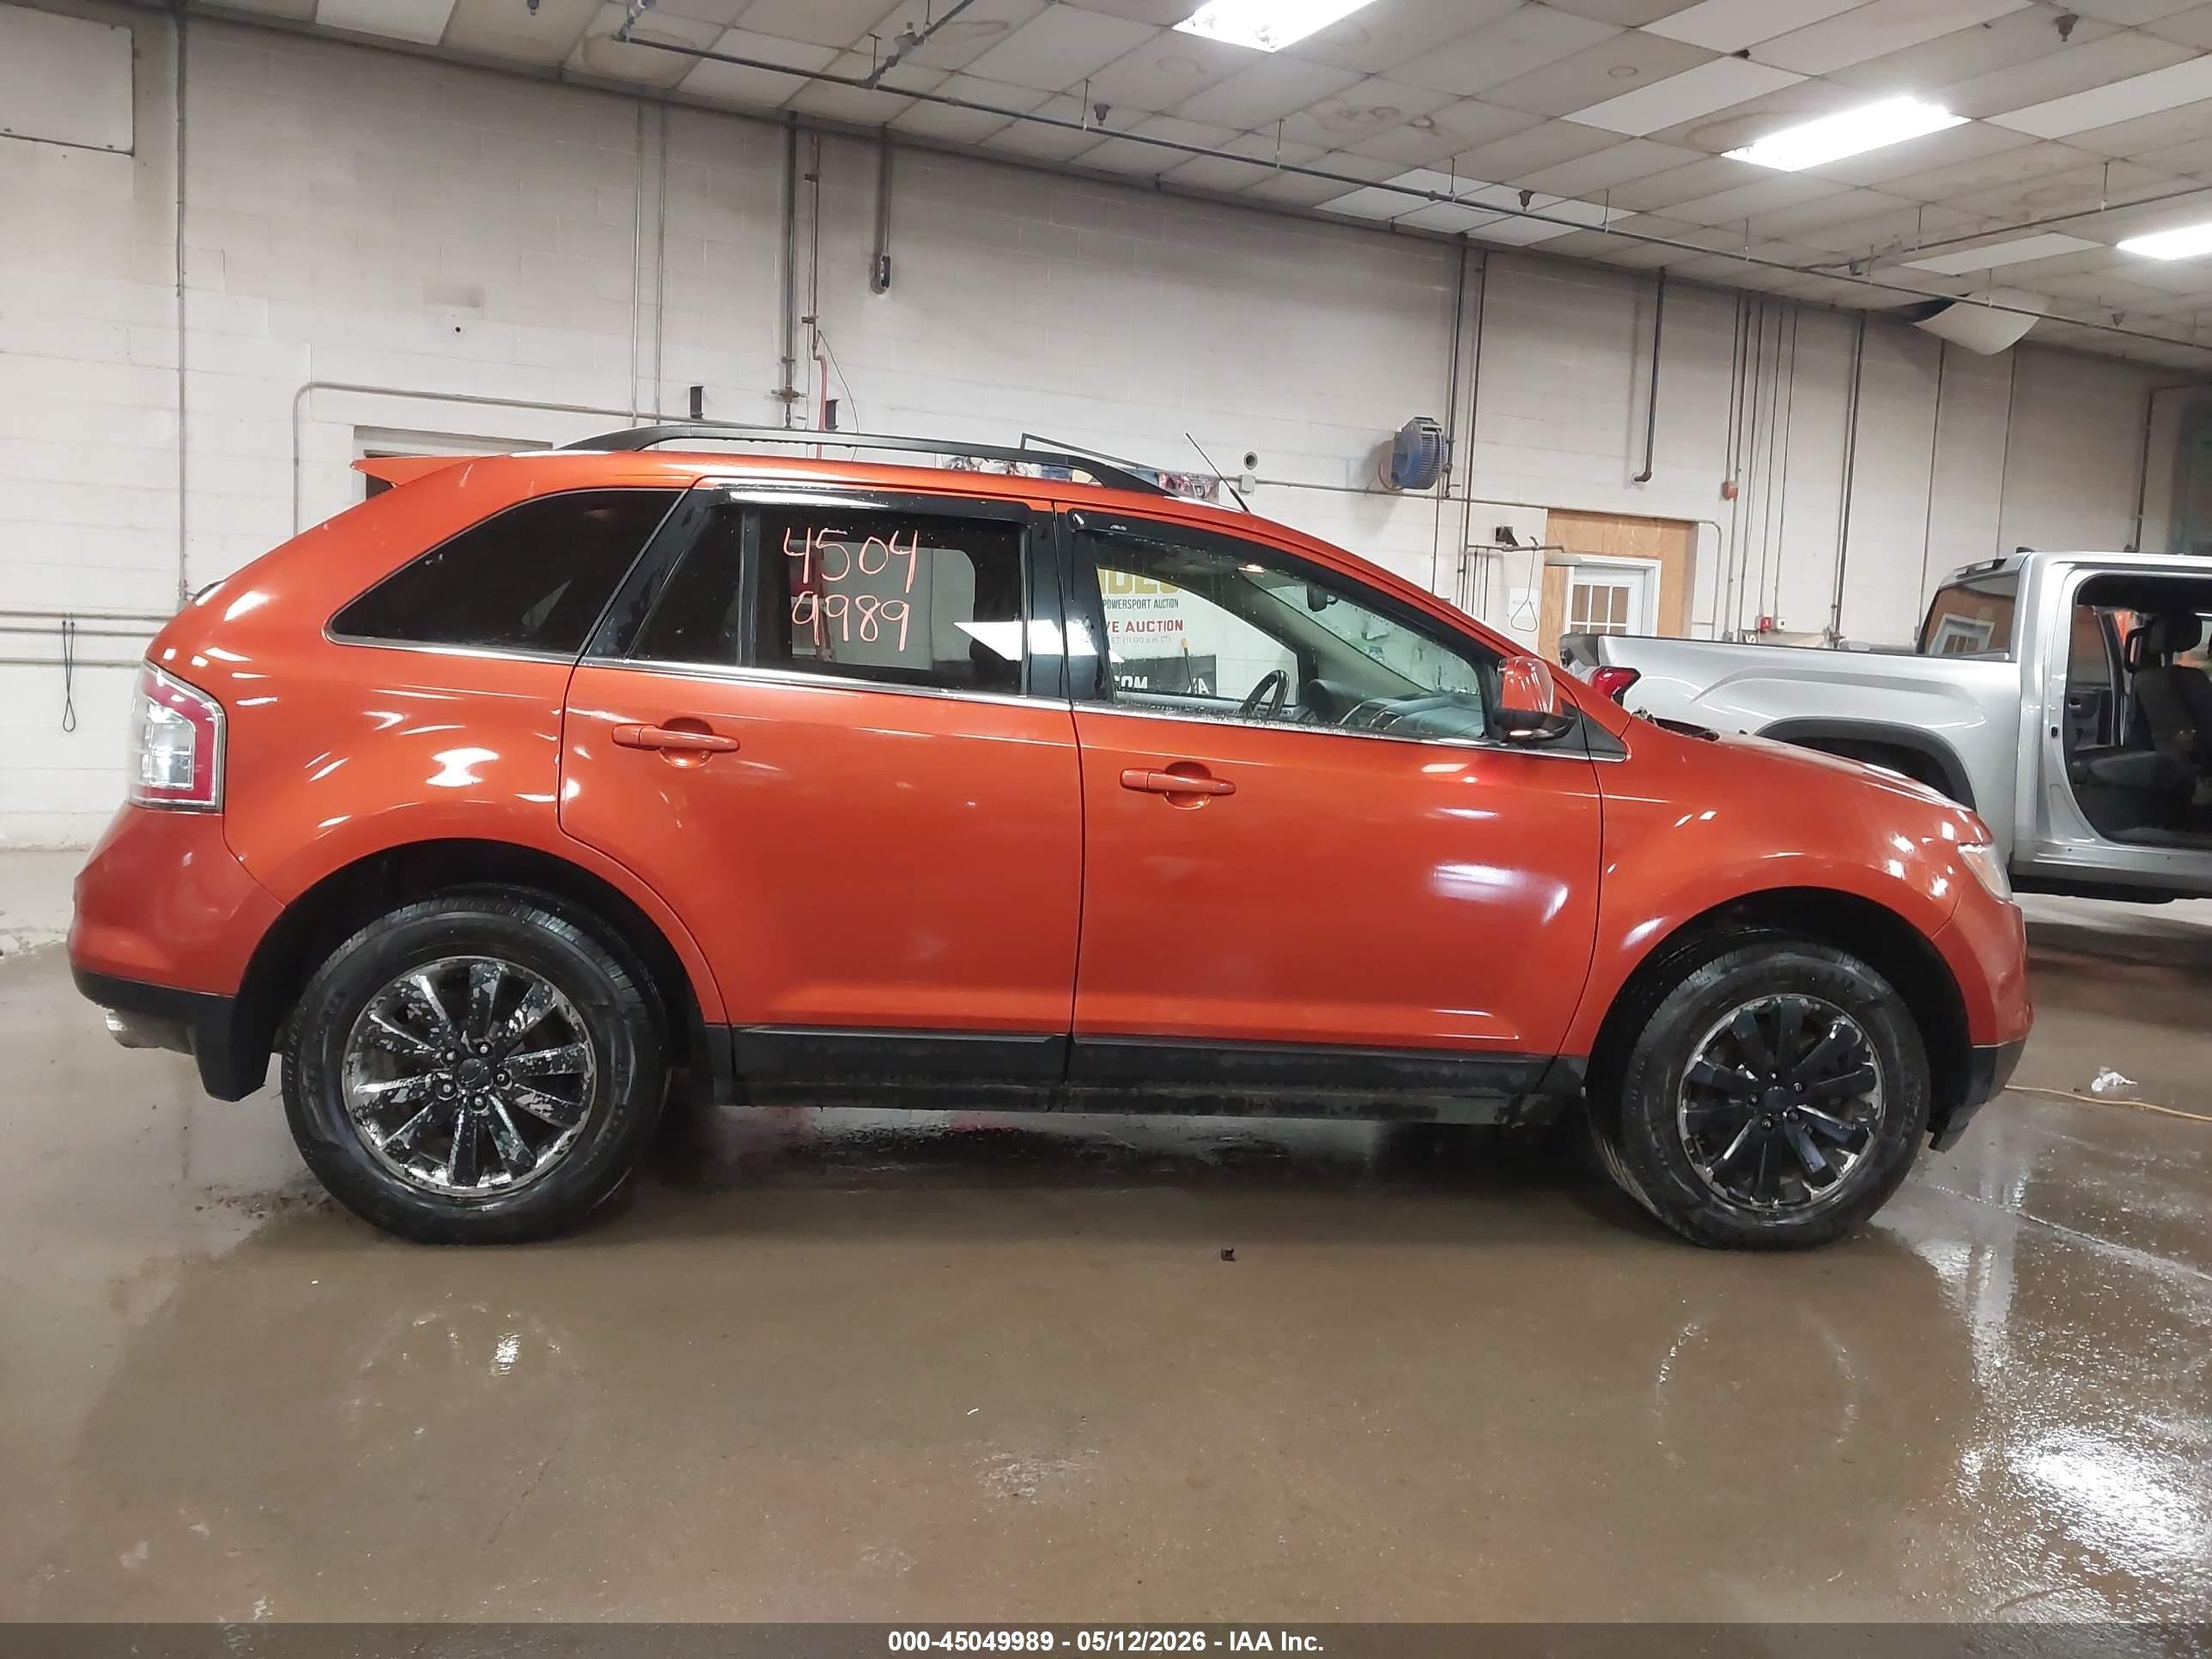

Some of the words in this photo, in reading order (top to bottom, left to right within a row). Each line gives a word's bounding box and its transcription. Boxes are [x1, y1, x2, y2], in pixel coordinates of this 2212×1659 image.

[782, 526, 918, 593] 4504
[792, 591, 910, 652] 9989
[1153, 598, 1179, 610] AUCTION
[1125, 619, 1183, 633] AUCTION
